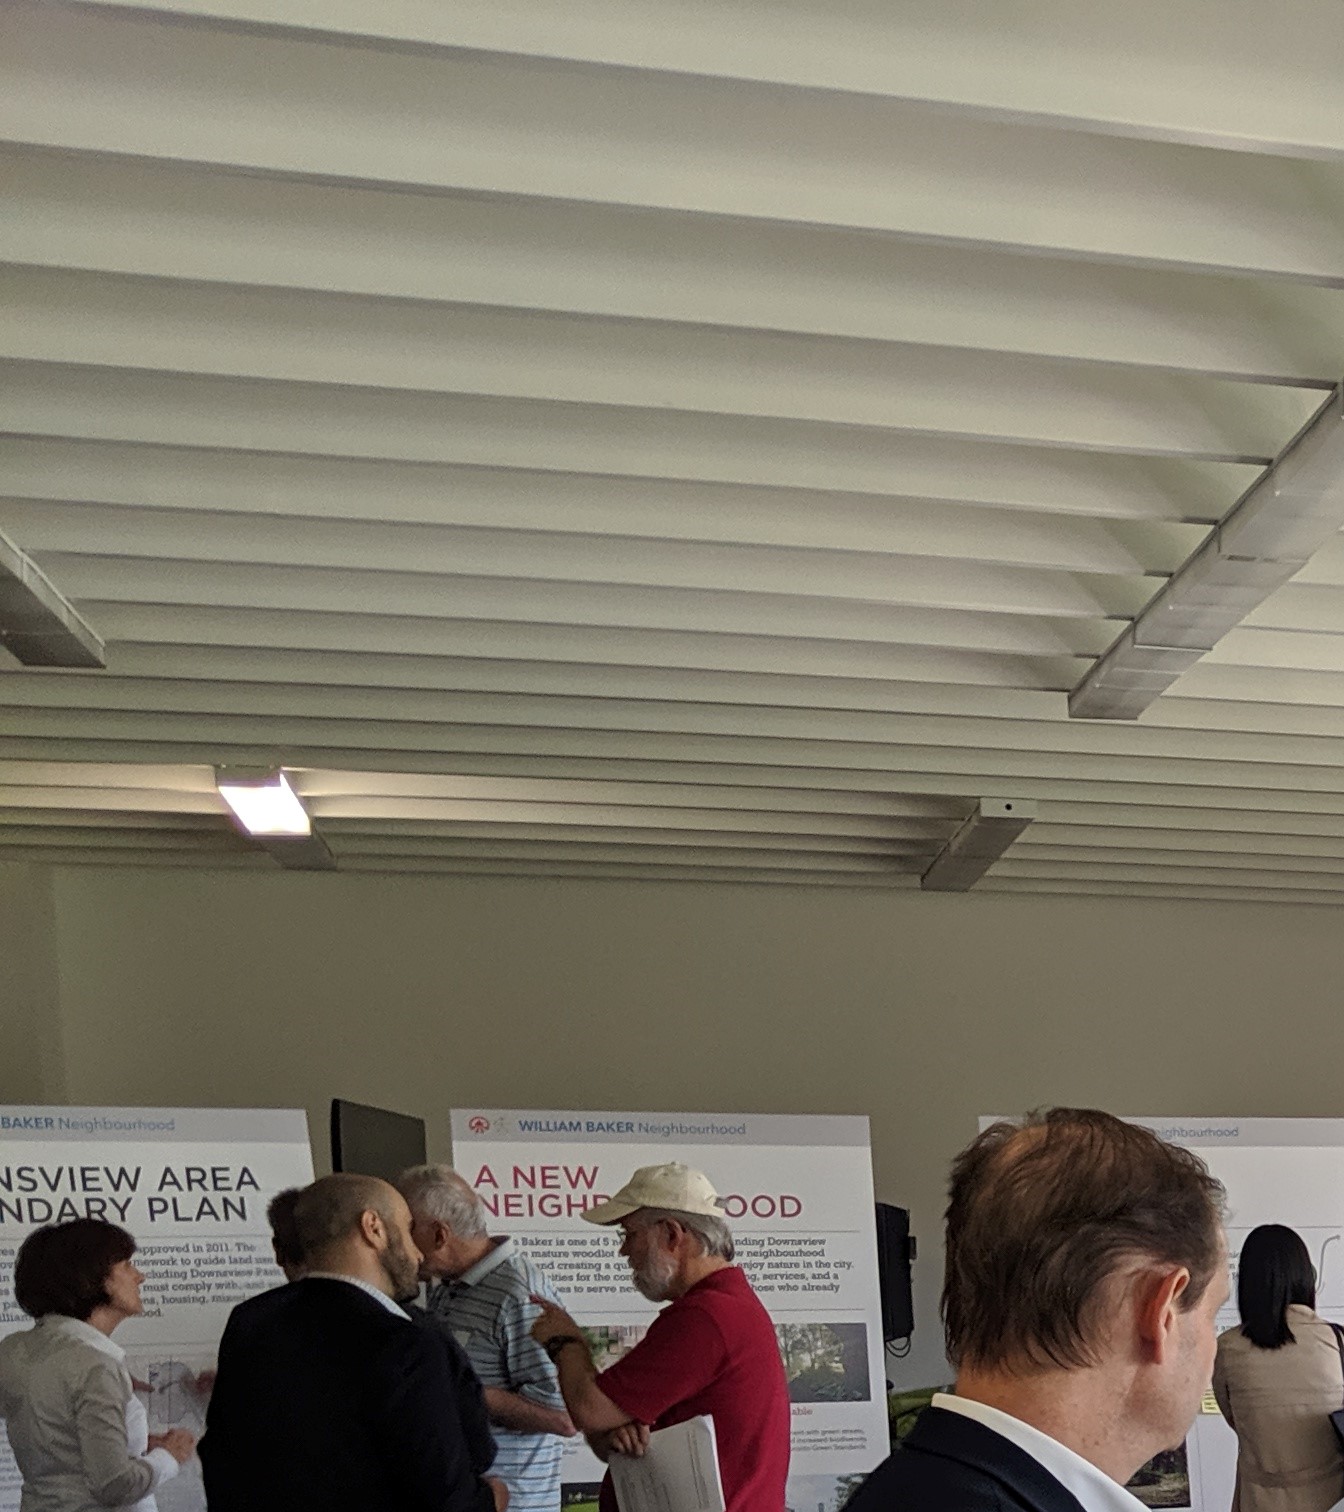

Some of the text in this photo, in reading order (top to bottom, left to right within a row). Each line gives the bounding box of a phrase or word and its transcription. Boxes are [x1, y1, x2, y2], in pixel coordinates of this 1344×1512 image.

[0, 1117, 176, 1133] BAKER Neighbourhood
[519, 1120, 746, 1137] WILLIAM BAKER Neighbourhood
[158, 1166, 261, 1191] AREA
[474, 1165, 599, 1189] A NEW
[147, 1196, 248, 1222] PLAN
[479, 1194, 802, 1218] NEIGHOOD
[522, 1237, 553, 1246] Baker
[555, 1238, 565, 1246] is
[591, 1237, 602, 1246] of
[602, 1238, 609, 1246] 5
[768, 1237, 826, 1246] Downsview
[193, 1244, 203, 1253] in
[531, 1249, 614, 1258] mature woodlot
[747, 1249, 825, 1259] neighbourhood
[180, 1257, 225, 1269] to guide
[557, 1262, 601, 1272] creating
[768, 1260, 854, 1270] nature in the city.
[576, 1273, 610, 1281] for the
[763, 1272, 808, 1281] services,
[811, 1271, 830, 1280] and
[777, 1282, 840, 1293] who already
